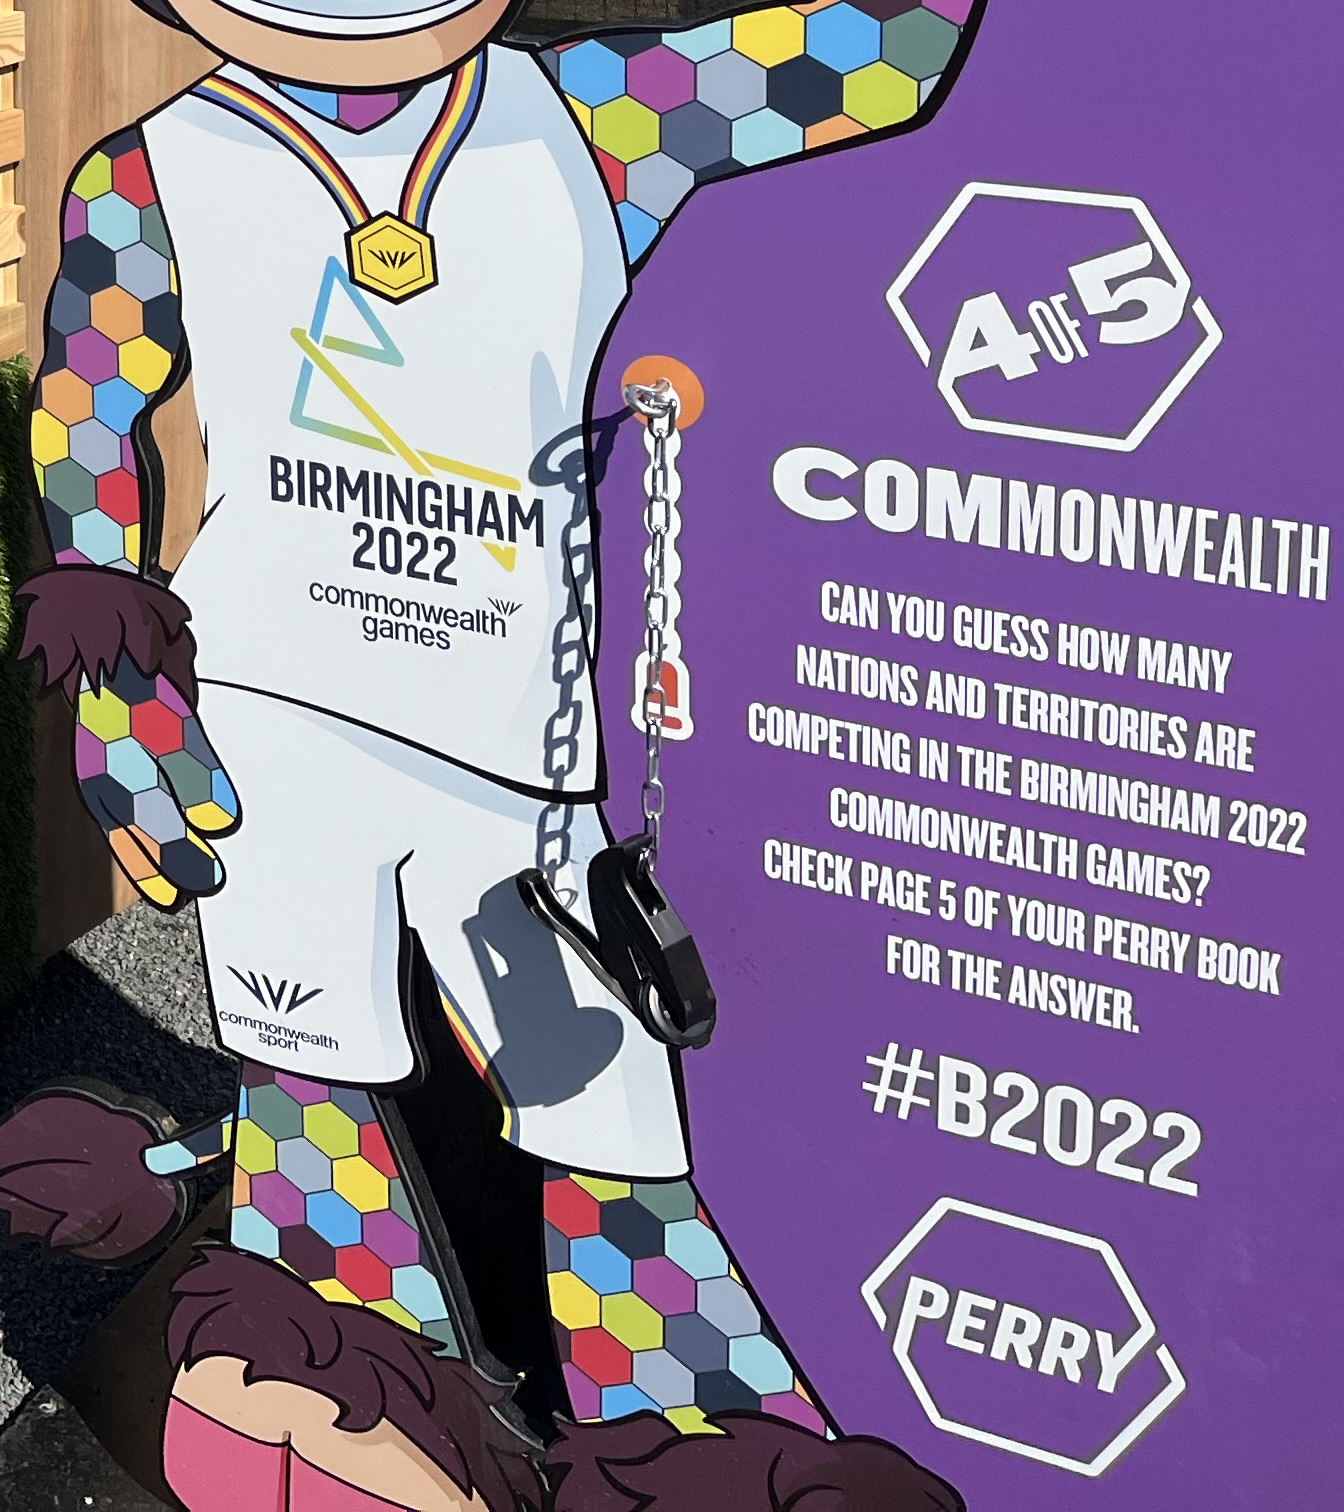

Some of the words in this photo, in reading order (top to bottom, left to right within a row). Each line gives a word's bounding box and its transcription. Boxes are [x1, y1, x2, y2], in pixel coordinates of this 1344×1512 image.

[939, 291, 1041, 381] 4
[1028, 293, 1089, 365] OF
[1068, 241, 1190, 344] 5
[269, 454, 545, 548] BIRMINGHAM
[352, 522, 458, 586] 2022
[772, 446, 1330, 601] COMMONWEALTH
[309, 581, 506, 638] commonwealth
[362, 614, 451, 650] games
[820, 580, 878, 630] CAN
[886, 591, 944, 642] YOU
[953, 605, 1049, 662] GUESS
[1057, 623, 1130, 676] HOW
[1137, 636, 1232, 694] MANY
[796, 644, 918, 707] NATIONS
[925, 670, 986, 720] AND
[993, 682, 1187, 759] TERRITORIES
[1195, 722, 1256, 773] ARE
[747, 702, 911, 776] COMPETING
[918, 737, 949, 783] IN
[956, 745, 1013, 796] THE
[1020, 759, 1220, 838] BIRMINGHAM
[1229, 800, 1308, 856] 2022
[829, 786, 1078, 880] COMMONWEALTH
[1086, 842, 1212, 907] GAMES?
[763, 839, 853, 897] CHECK
[860, 861, 932, 917] PAGE
[938, 881, 957, 921] 5
[965, 886, 1001, 931] OF
[1007, 894, 1086, 952] YOUR
[1093, 914, 1191, 974] PERRY
[1197, 937, 1282, 996] BOOK
[218, 1010, 339, 1051] commonwealth
[258, 1031, 299, 1052] sport
[886, 934, 941, 986] FOR
[946, 949, 1003, 1002] THE
[1007, 965, 1140, 1035] ANSWER.
[862, 1042, 1203, 1197] #B2022
[908, 1275, 1150, 1394] PERRY
